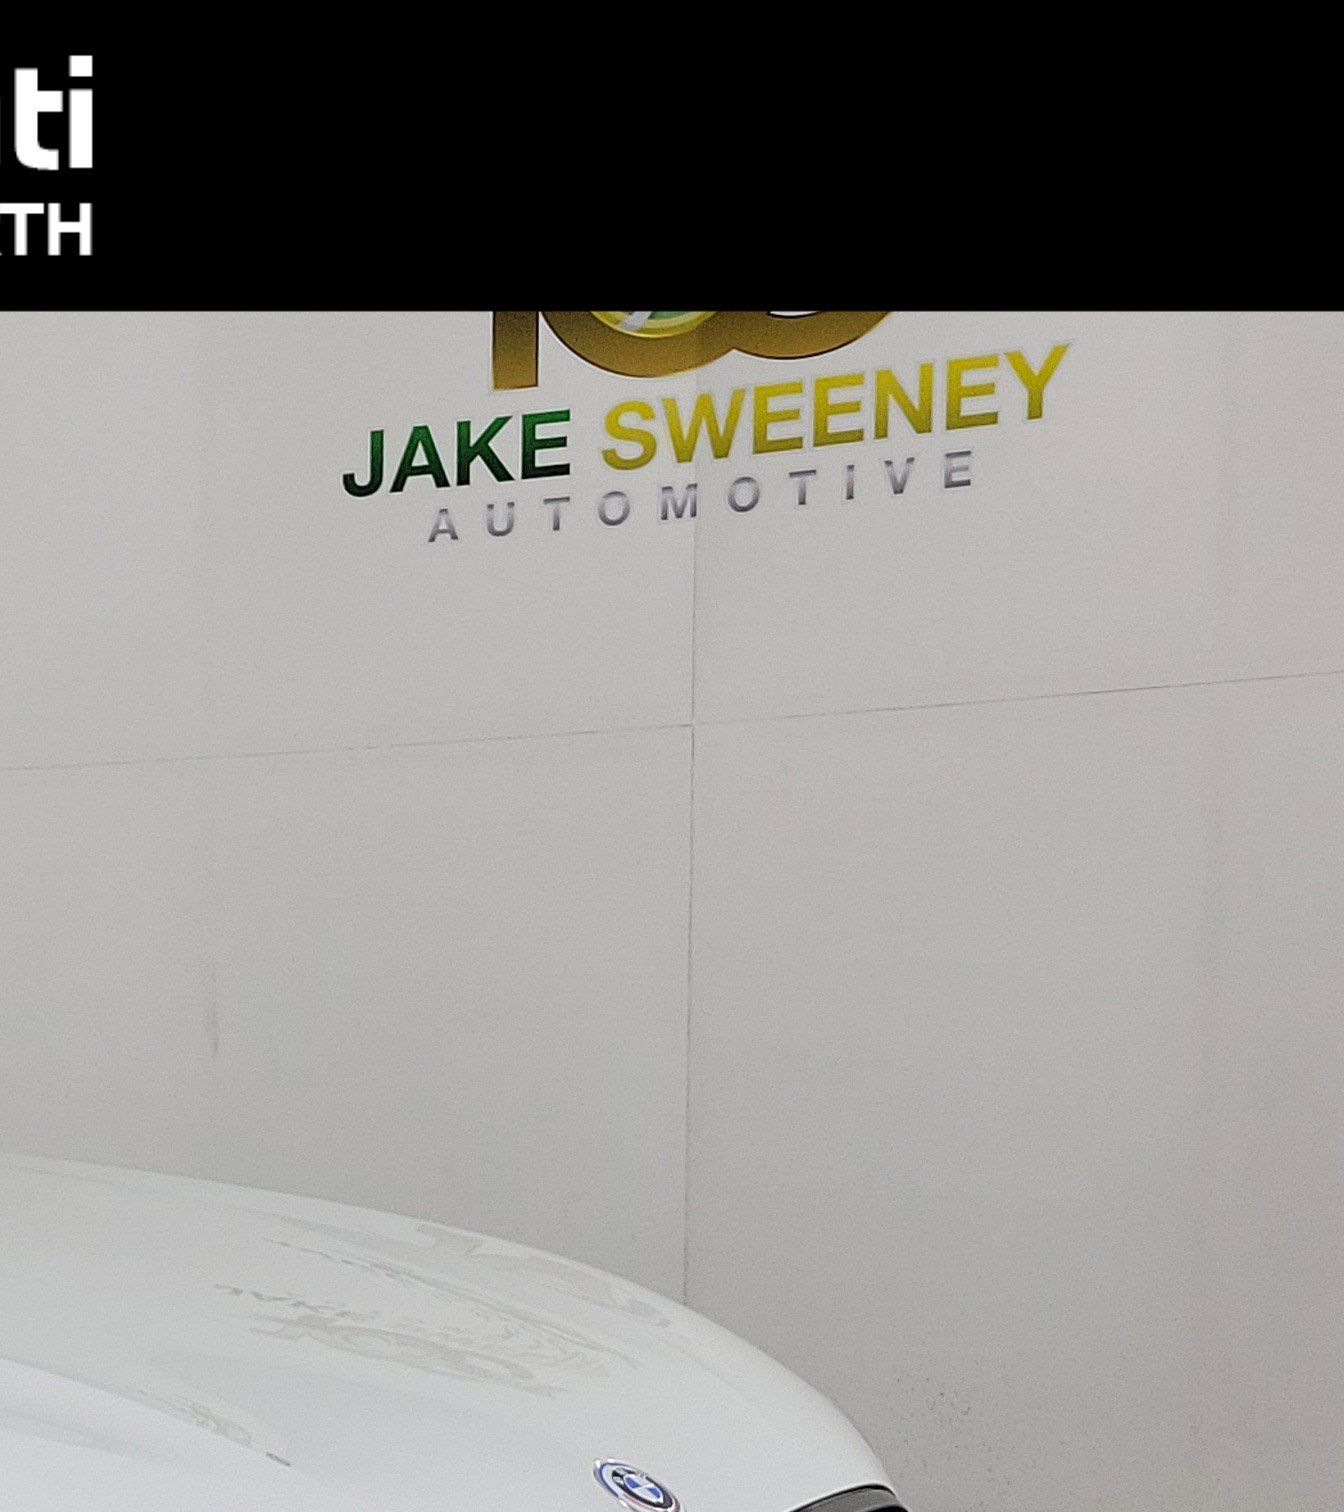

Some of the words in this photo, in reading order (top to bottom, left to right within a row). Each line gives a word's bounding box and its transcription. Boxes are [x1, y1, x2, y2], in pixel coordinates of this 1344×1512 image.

[342, 410, 571, 497] JAKE
[600, 343, 1070, 471] SWEENEY
[427, 449, 973, 543] AUTOMOTIVE
